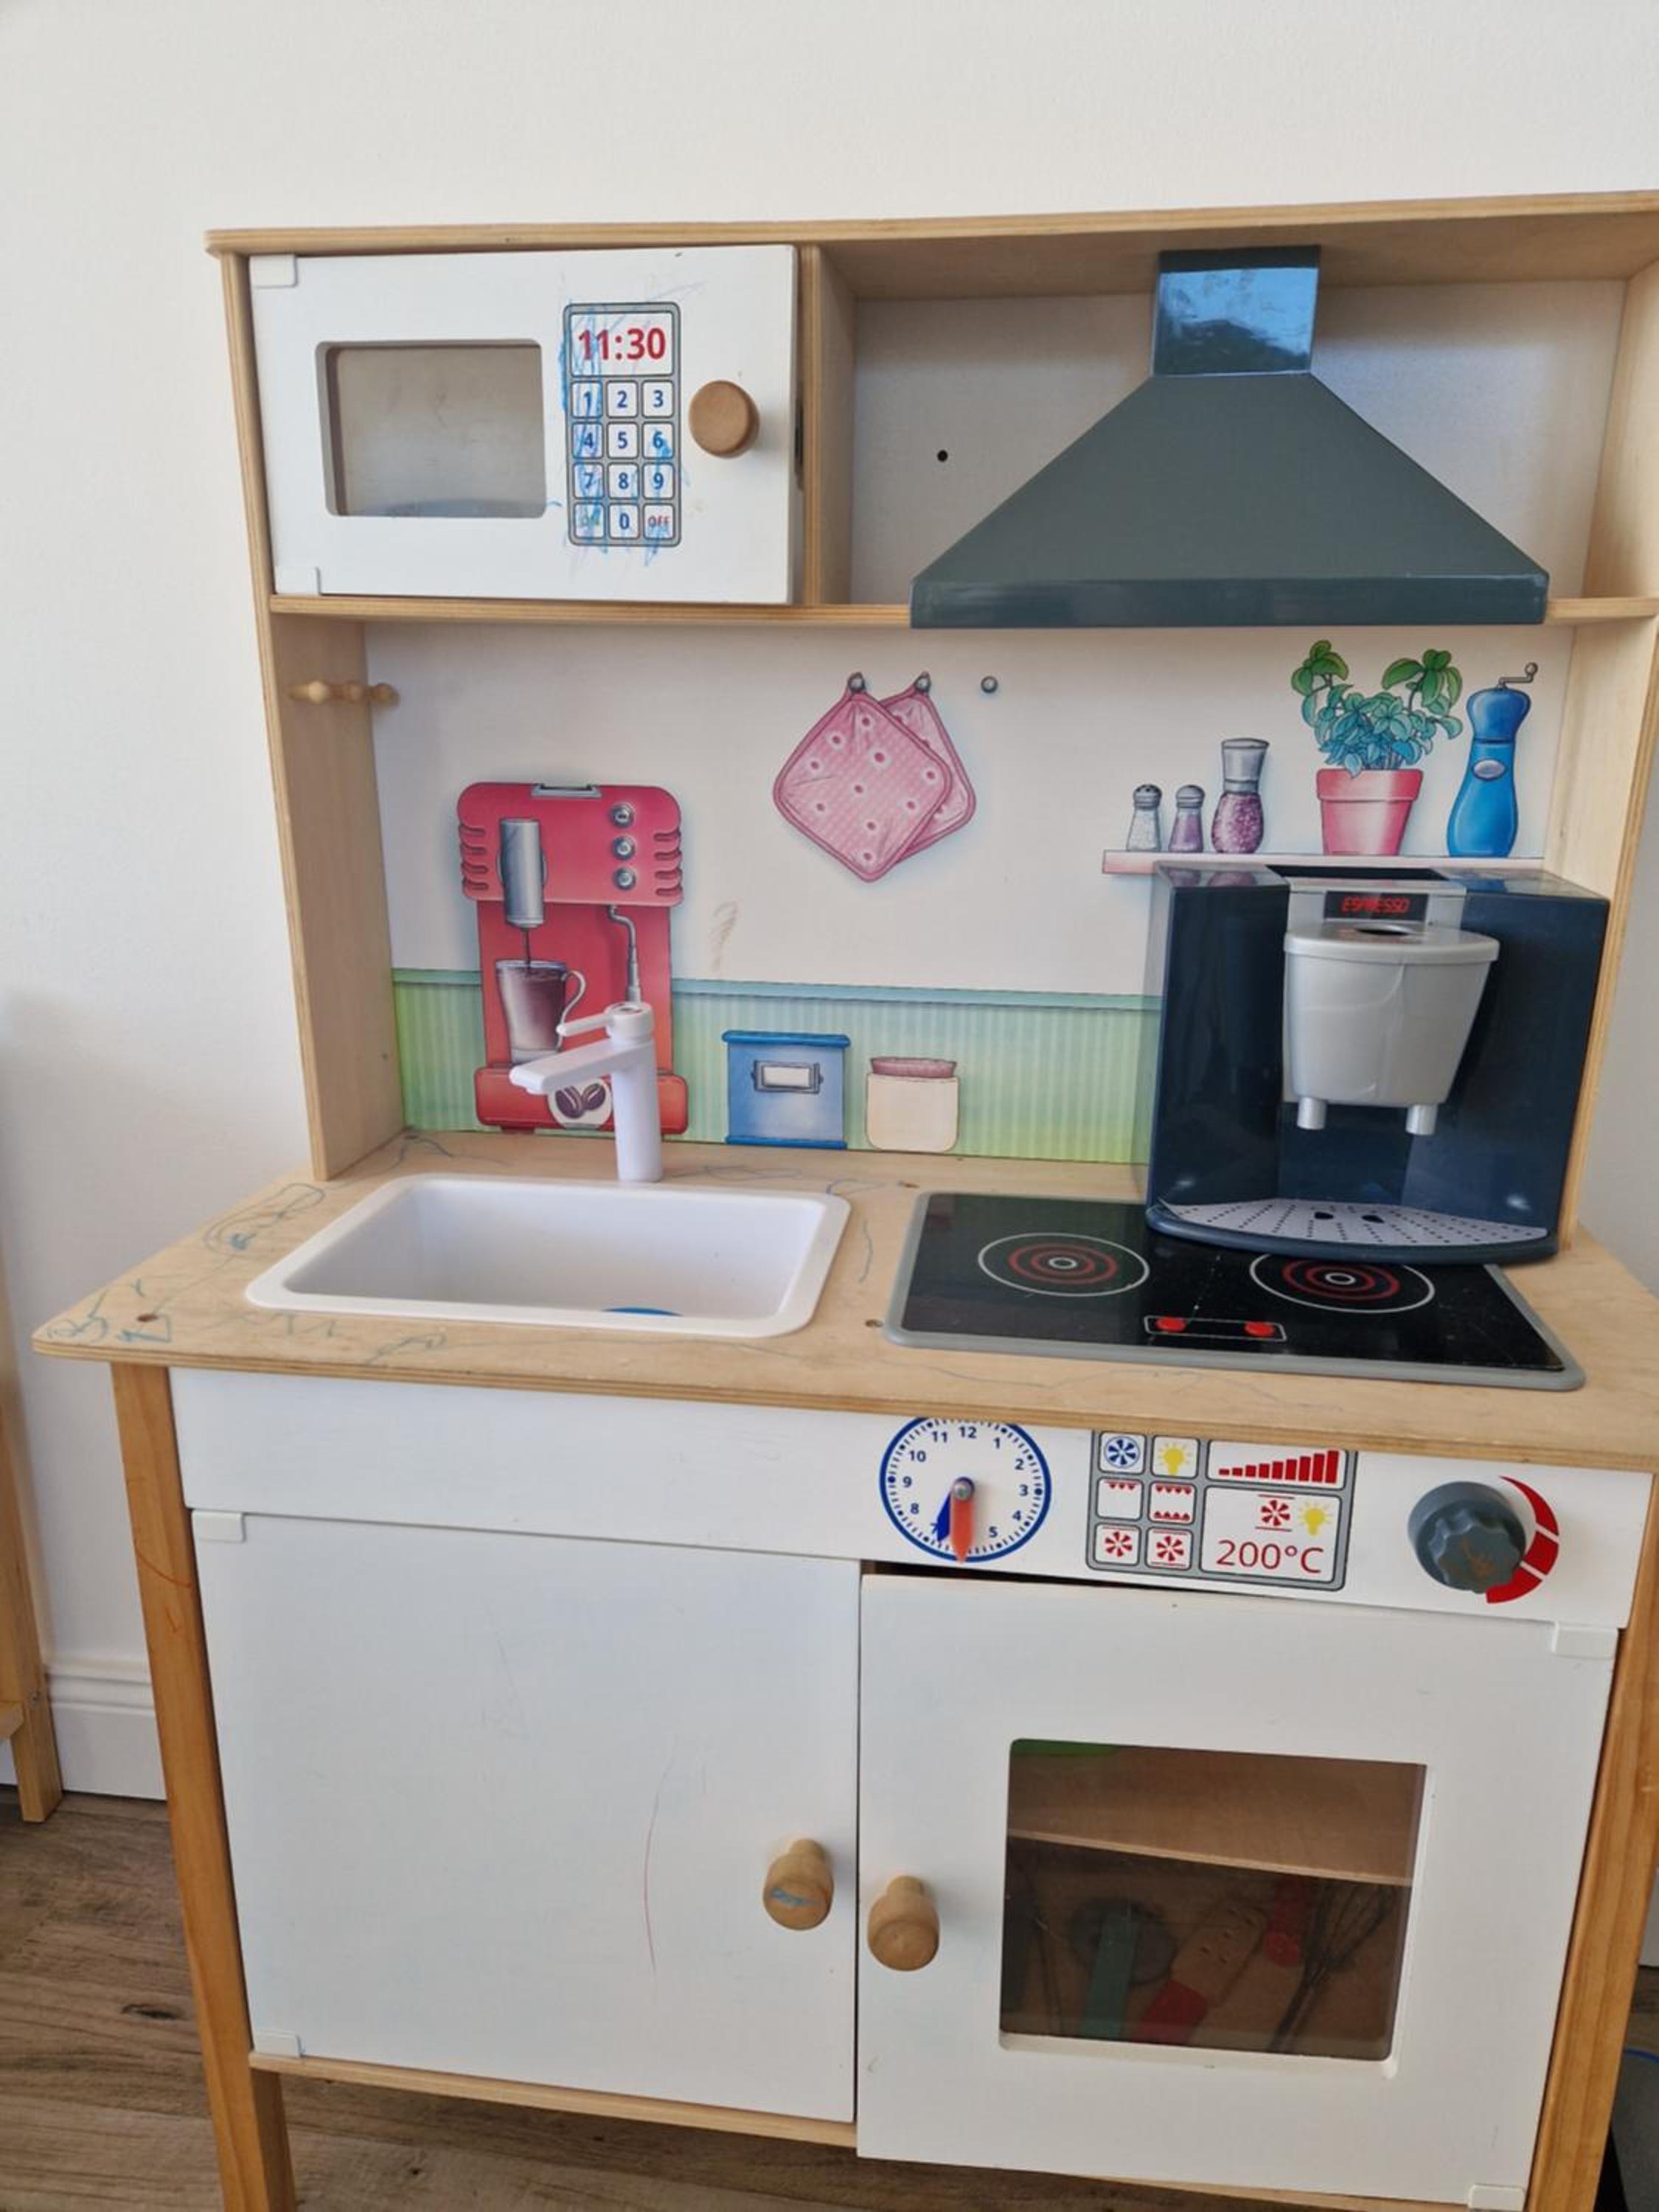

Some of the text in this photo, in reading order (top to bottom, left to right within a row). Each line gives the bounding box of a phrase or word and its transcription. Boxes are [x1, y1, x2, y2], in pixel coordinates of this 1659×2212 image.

[578, 328, 666, 361] 11:30
[583, 392, 591, 408] 1
[616, 391, 627, 408] 2
[653, 390, 664, 407] 3
[582, 432, 593, 449] 4
[617, 431, 627, 449] 5
[653, 431, 664, 449] 6
[583, 473, 594, 489] 7
[618, 472, 628, 490] 8
[653, 472, 664, 490] 9
[619, 512, 630, 529] 0
[932, 1431, 948, 1443] 11
[959, 1426, 977, 1439] 12
[993, 1438, 1000, 1449] 1
[909, 1450, 927, 1462] 10
[1015, 1458, 1024, 1470] 2
[902, 1476, 912, 1488] 9
[1020, 1484, 1029, 1497] 3
[910, 1503, 919, 1514] 8
[1012, 1510, 1022, 1521] 4
[989, 1526, 998, 1538] 5
[1216, 1540, 1324, 1573] 200°C
